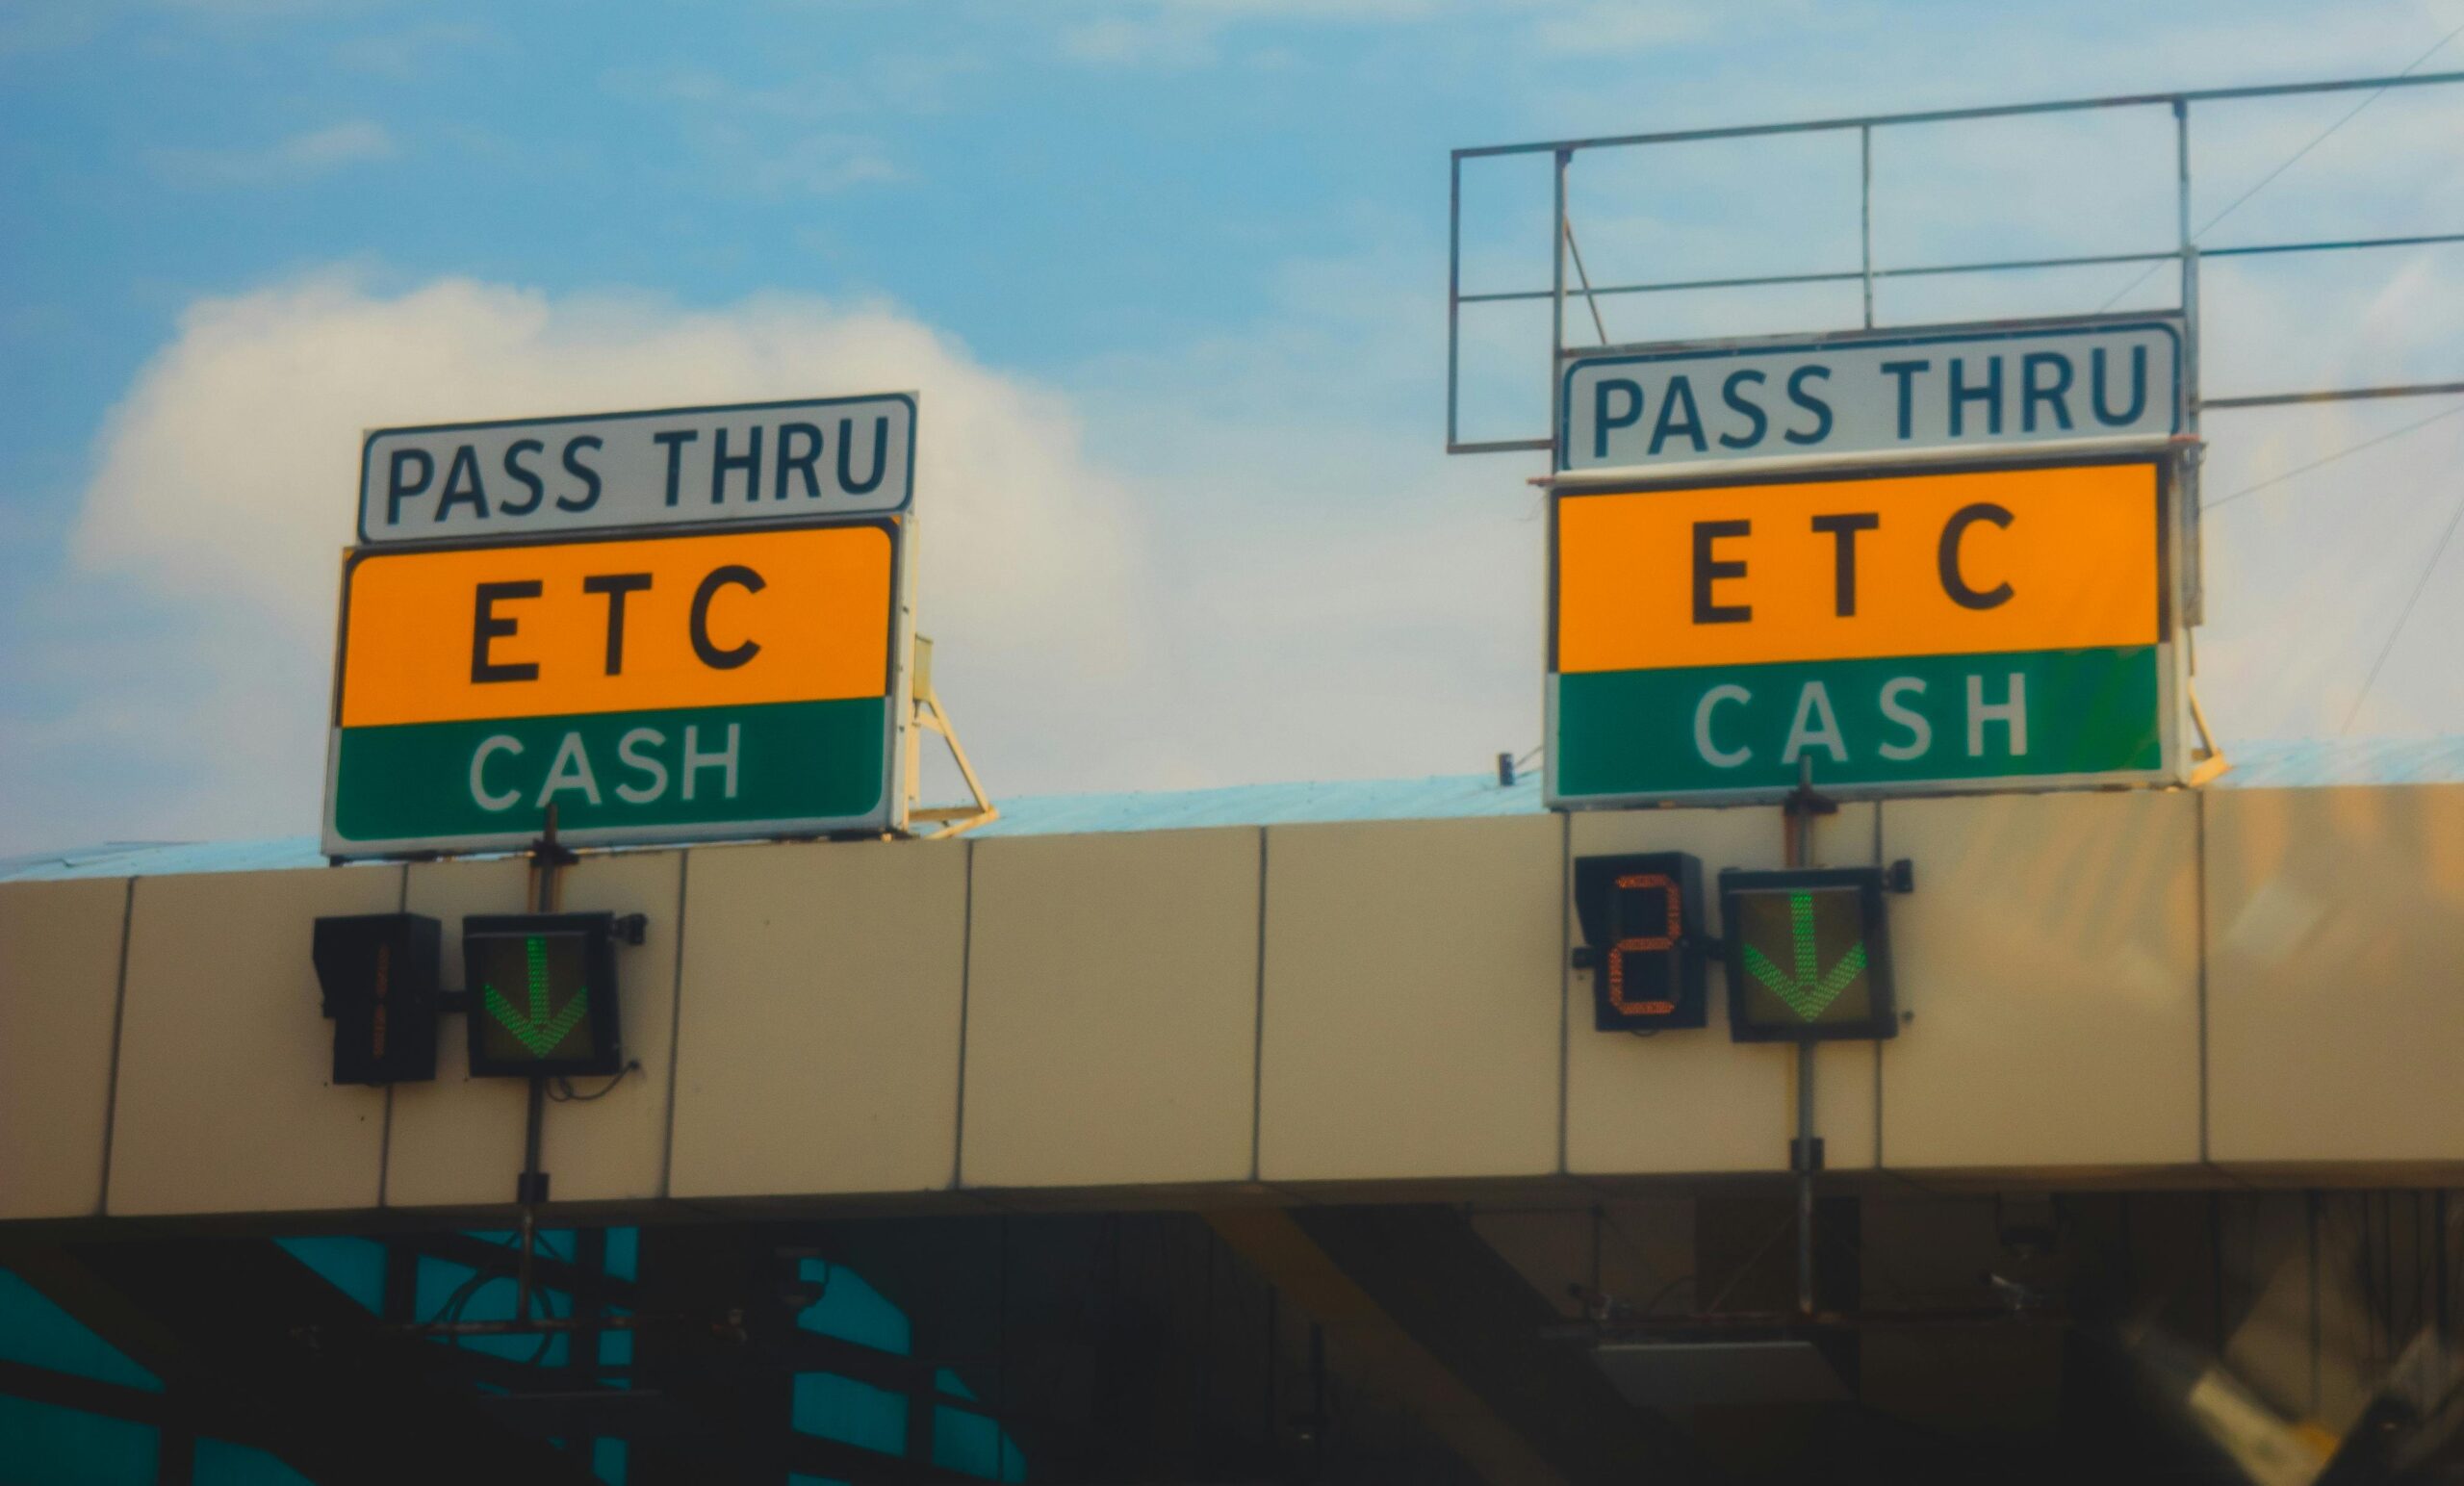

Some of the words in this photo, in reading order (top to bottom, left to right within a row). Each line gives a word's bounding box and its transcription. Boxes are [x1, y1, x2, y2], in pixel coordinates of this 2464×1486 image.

[1593, 365, 1834, 459] PASS
[1880, 345, 2147, 440] THRU
[386, 435, 603, 525] PASS
[653, 416, 889, 506] THRU
[1692, 501, 2015, 625] ETC
[471, 564, 767, 685] ETC
[469, 723, 740, 812] CASH
[1693, 672, 2028, 767] CASH
[1608, 873, 1681, 1015] 2
